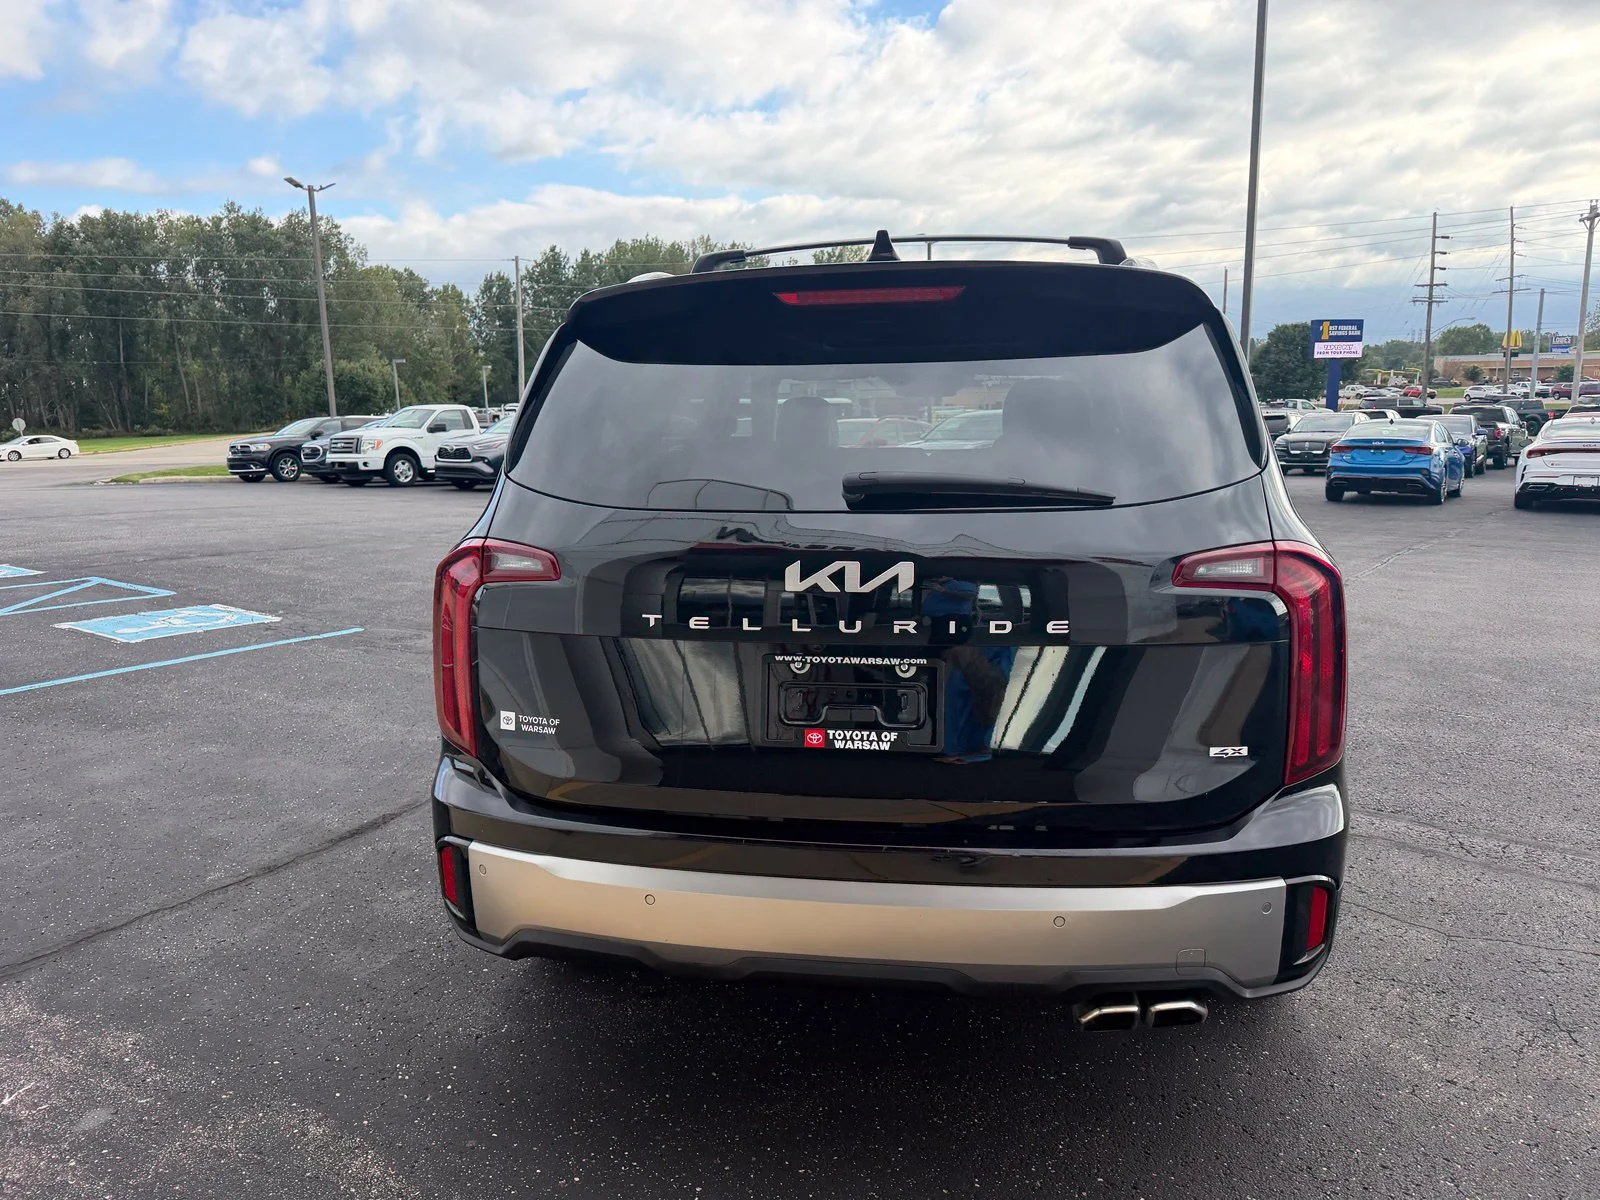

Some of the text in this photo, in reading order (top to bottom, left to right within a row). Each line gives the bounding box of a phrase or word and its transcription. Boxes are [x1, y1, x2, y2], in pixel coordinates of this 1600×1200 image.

[785, 560, 915, 593] KIA
[642, 613, 1071, 634] TELLURIDE
[775, 654, 928, 665] www.TOYOTAWARSAW.com
[518, 714, 561, 726] TOYOTA OF
[521, 724, 556, 735] WARSAW
[827, 729, 899, 742] TOYOTA OF
[834, 739, 891, 751] WARSAW
